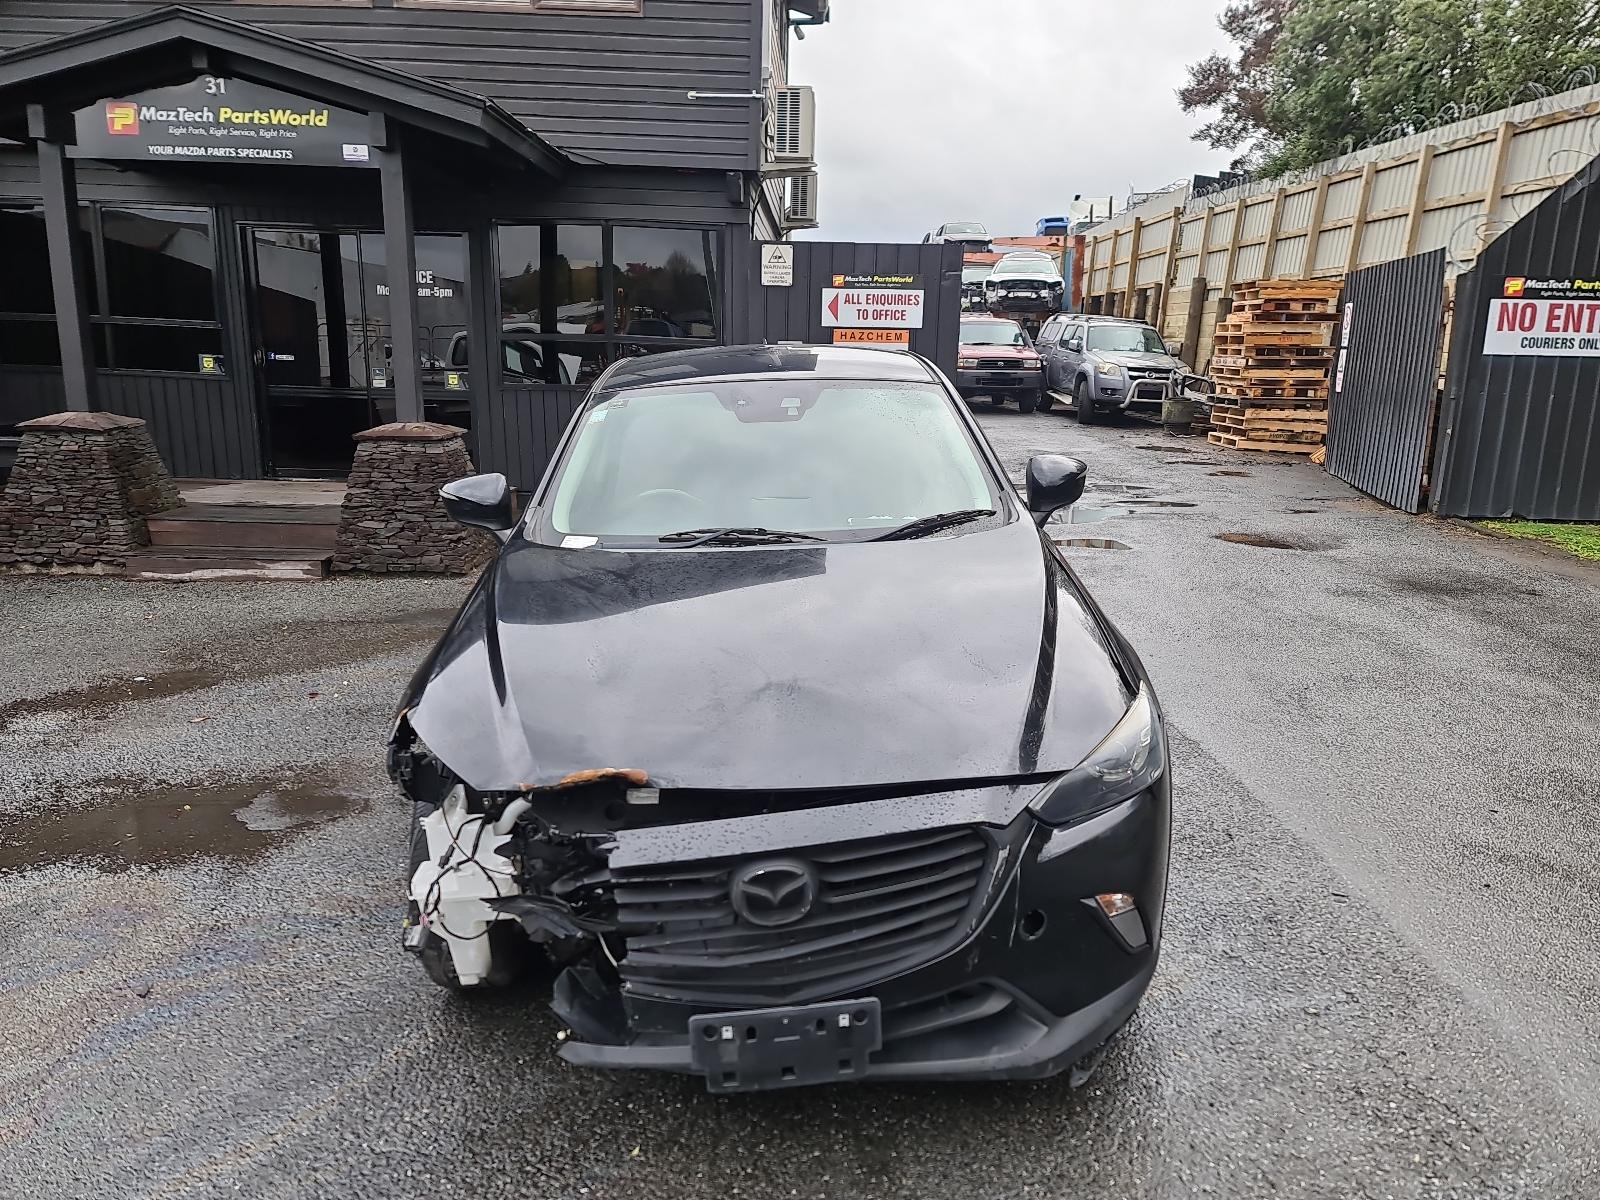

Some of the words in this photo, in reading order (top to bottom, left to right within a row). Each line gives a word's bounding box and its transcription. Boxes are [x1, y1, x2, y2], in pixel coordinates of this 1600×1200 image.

[205, 77, 226, 94] 31
[139, 106, 215, 123] MazTech
[219, 107, 329, 127] PartsWorld
[168, 125, 187, 136] Right
[188, 126, 208, 135] Parts,
[209, 126, 228, 136] Right
[229, 128, 258, 137] Service,
[259, 128, 278, 138] Right
[279, 129, 297, 138] Price
[148, 145, 174, 155] YOUR
[174, 146, 206, 156] MAZDA
[207, 147, 236, 157] PARTS
[237, 148, 293, 159] SPECIALISTS
[416, 271, 433, 284] ICE
[873, 275, 913, 283] PartsWorld
[1525, 279, 1571, 289] MazTech
[376, 284, 390, 296] Mo
[417, 286, 453, 298] am-5pm
[844, 293, 862, 305] ALL
[866, 294, 920, 306] ENQUIRIES
[857, 309, 869, 321] TO
[872, 309, 906, 321] OFFICE
[1497, 302, 1538, 333] NO
[1545, 303, 1600, 334] ENT
[840, 331, 903, 341] HAZCHEM
[1520, 337, 1576, 350] COURIERS
[1578, 338, 1600, 350] ONL
